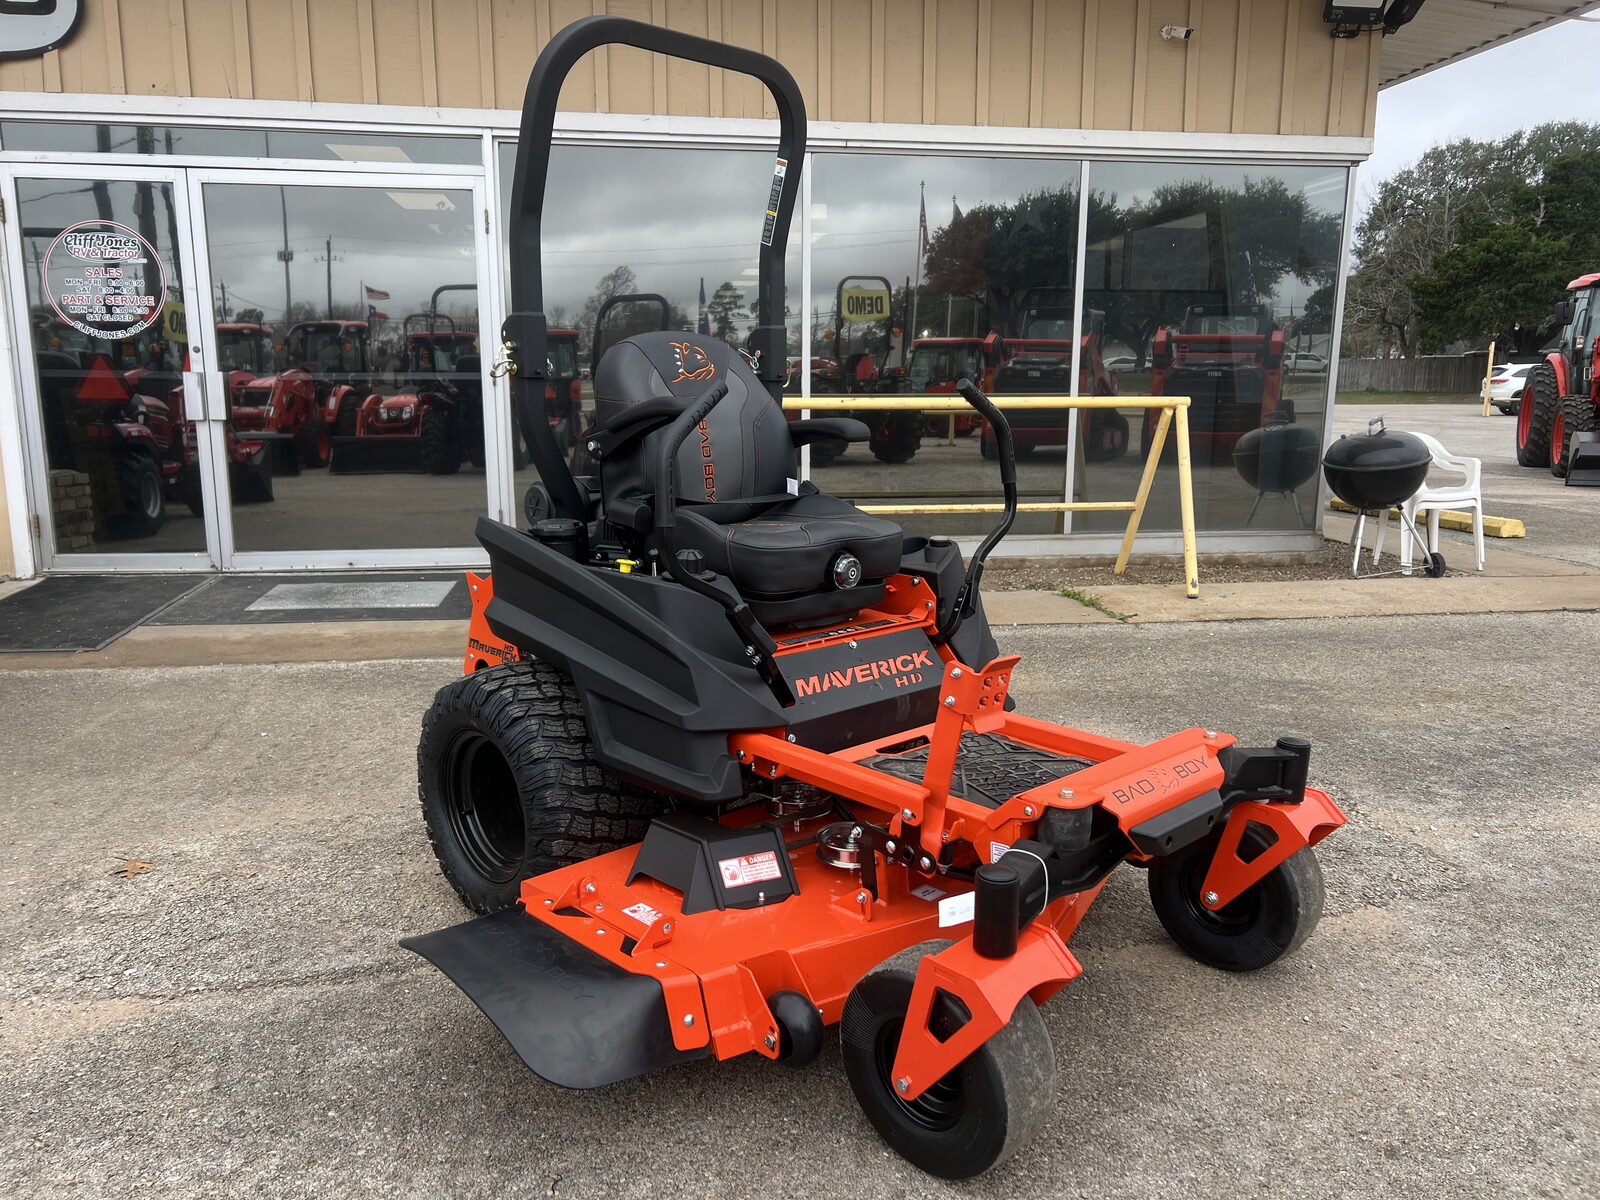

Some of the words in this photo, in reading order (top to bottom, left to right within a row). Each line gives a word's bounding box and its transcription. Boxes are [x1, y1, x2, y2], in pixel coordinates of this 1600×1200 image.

[64, 233, 97, 248] Cliff
[97, 234, 138, 247] Jones
[73, 247, 88, 257] RV
[90, 248, 100, 257] &
[102, 247, 139, 258] Tractor
[85, 267, 123, 278] SALES
[65, 278, 83, 286] MON
[62, 295, 92, 305] PART
[95, 296, 104, 305] &
[105, 296, 155, 306] SERVICE
[73, 320, 148, 339] CLIFFJONES.COM
[698, 418, 713, 459] BAD
[703, 463, 717, 503] BOY
[795, 649, 935, 697] MAVERICK
[895, 672, 923, 688] HD
[1112, 779, 1155, 804] BAD
[1172, 756, 1208, 779] BOY
[748, 853, 775, 864] DANGER
